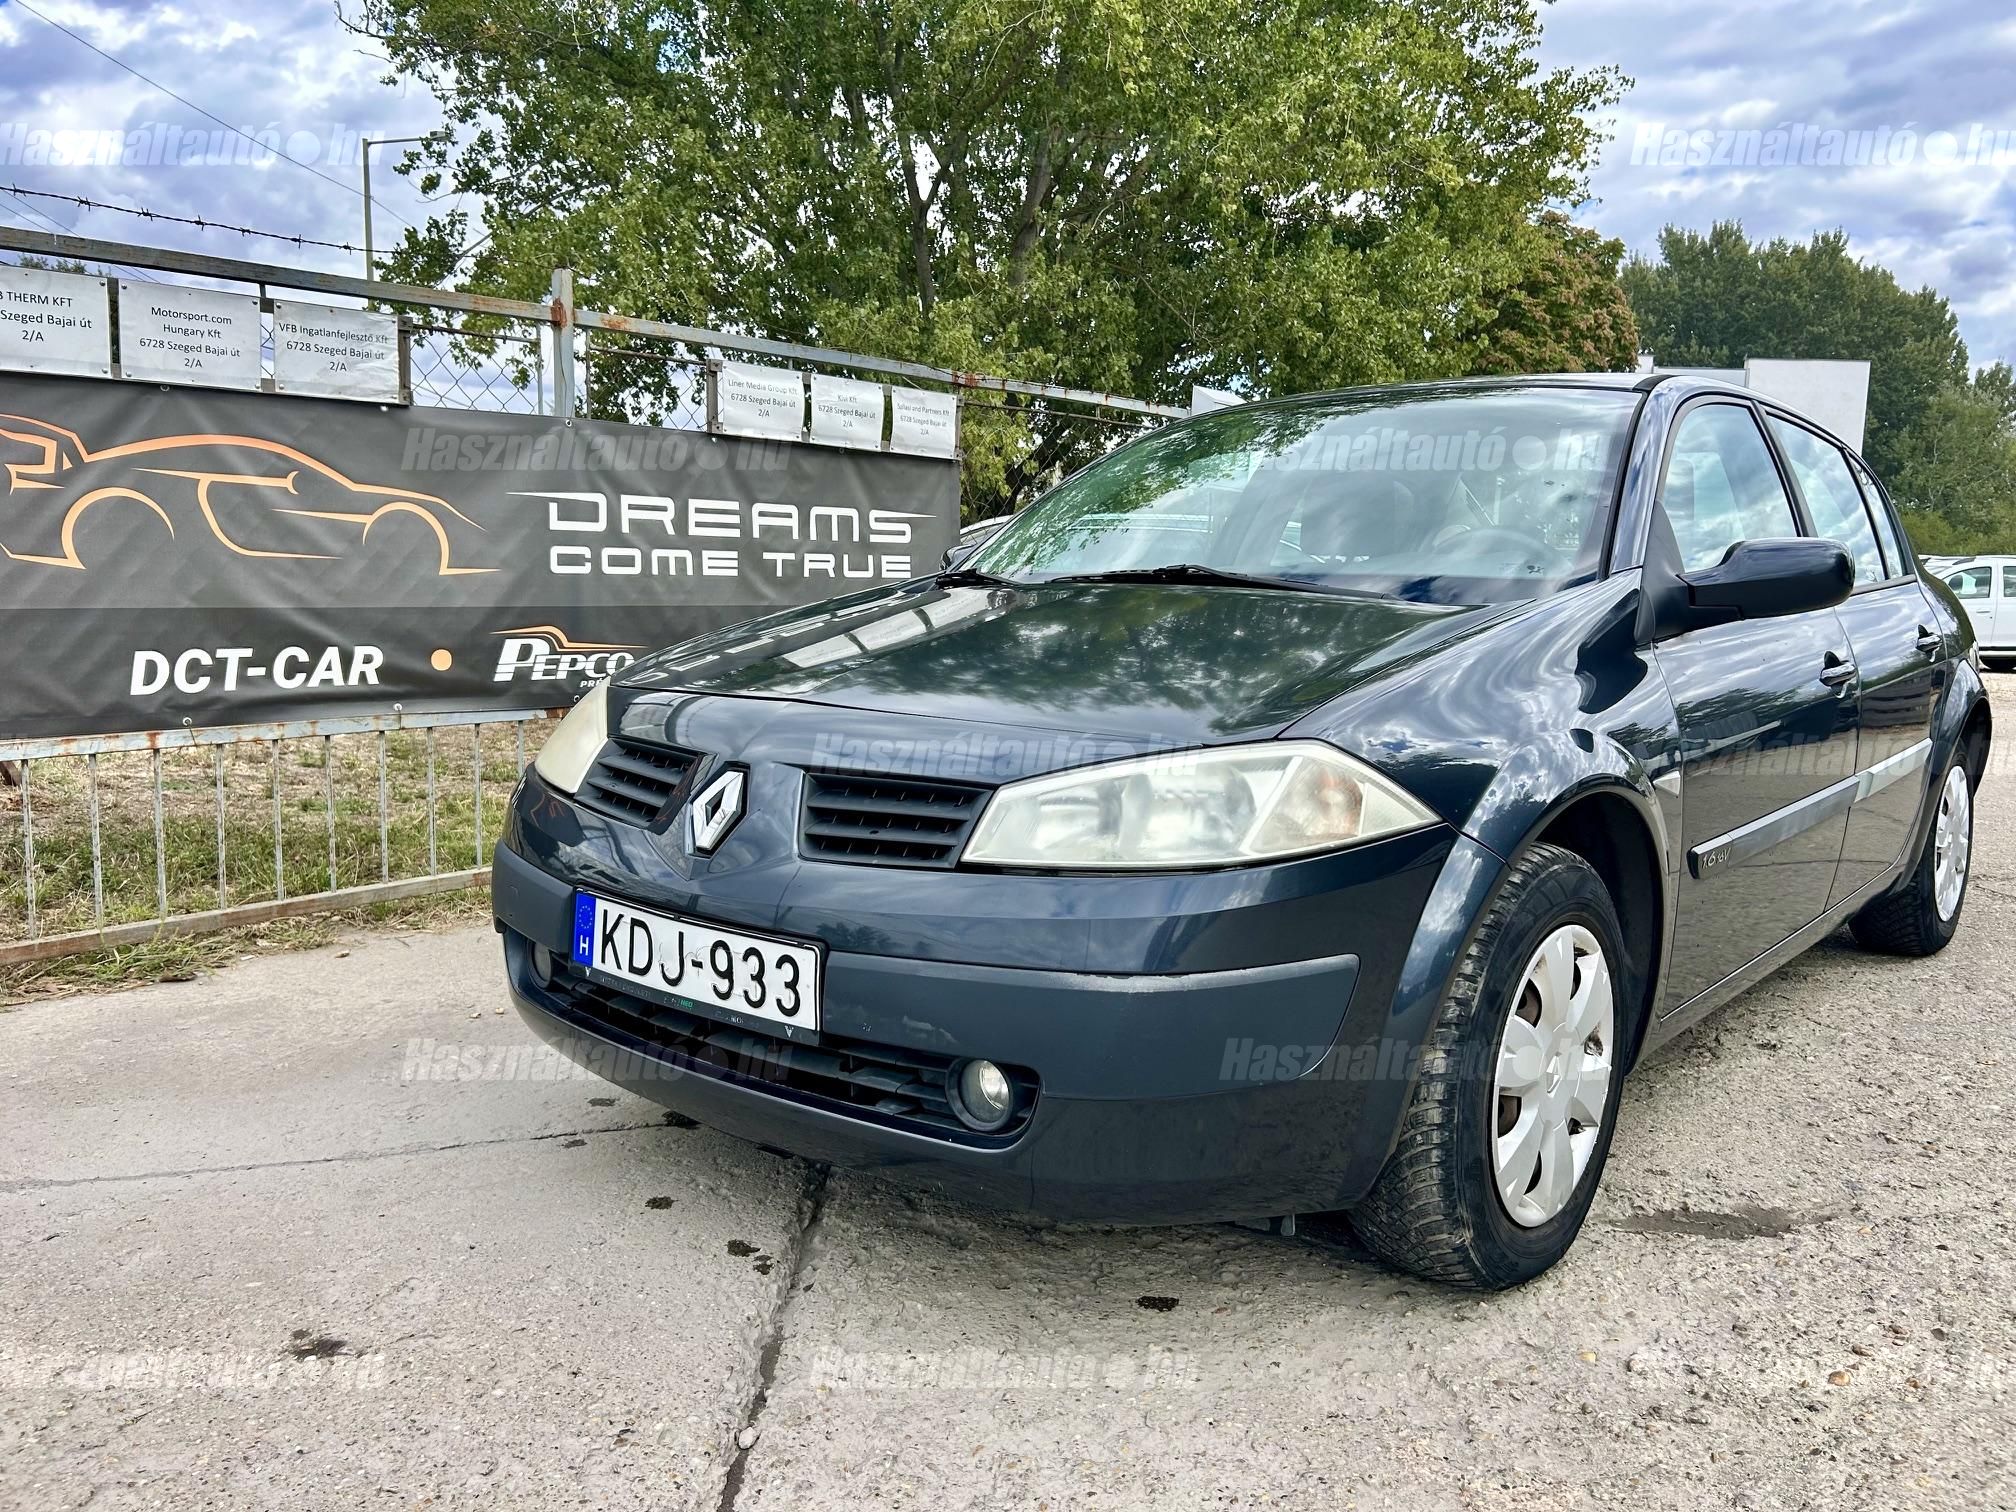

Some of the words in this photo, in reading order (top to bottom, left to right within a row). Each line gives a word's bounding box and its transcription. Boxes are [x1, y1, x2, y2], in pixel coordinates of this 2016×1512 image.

[6, 291, 49, 305] THERM
[52, 296, 73, 307] KFT
[0, 309, 43, 324] Szeged
[47, 314, 76, 328] Bajai
[79, 317, 92, 328] út
[151, 306, 232, 325] Motorsport.com
[22, 329, 44, 342] 2/A
[163, 323, 205, 338] Hungary
[207, 328, 222, 339] Kft
[278, 322, 297, 333] VFB
[299, 325, 374, 342] Ingatlanfejlesztő
[375, 334, 388, 344] Kft
[139, 337, 165, 349] 6728
[167, 340, 202, 354] Szeged
[205, 344, 228, 357] Bajai
[230, 347, 240, 357] út
[286, 340, 312, 352] 6728
[314, 343, 347, 356] Szeged
[349, 347, 372, 359] Bajai
[374, 350, 385, 360] út
[184, 357, 203, 368] 2/A
[329, 361, 347, 372] 2/A
[746, 381, 767, 391] Media
[767, 384, 788, 394] Group
[730, 392, 748, 402] 6728
[748, 395, 772, 406] Szeged
[772, 398, 788, 408] Bajai
[788, 400, 796, 408] út
[758, 408, 770, 418] 2/A
[818, 404, 833, 414] 6728
[834, 406, 854, 417] Szeged
[854, 409, 868, 419] Bajai
[842, 419, 854, 428] 2/A
[506, 492, 937, 544] DREAMS
[549, 545, 739, 577] COME
[762, 551, 912, 579] TRUE
[130, 645, 384, 696] DCT-CAR
[579, 935, 590, 956] H
[600, 909, 801, 1017] KDJ-933
